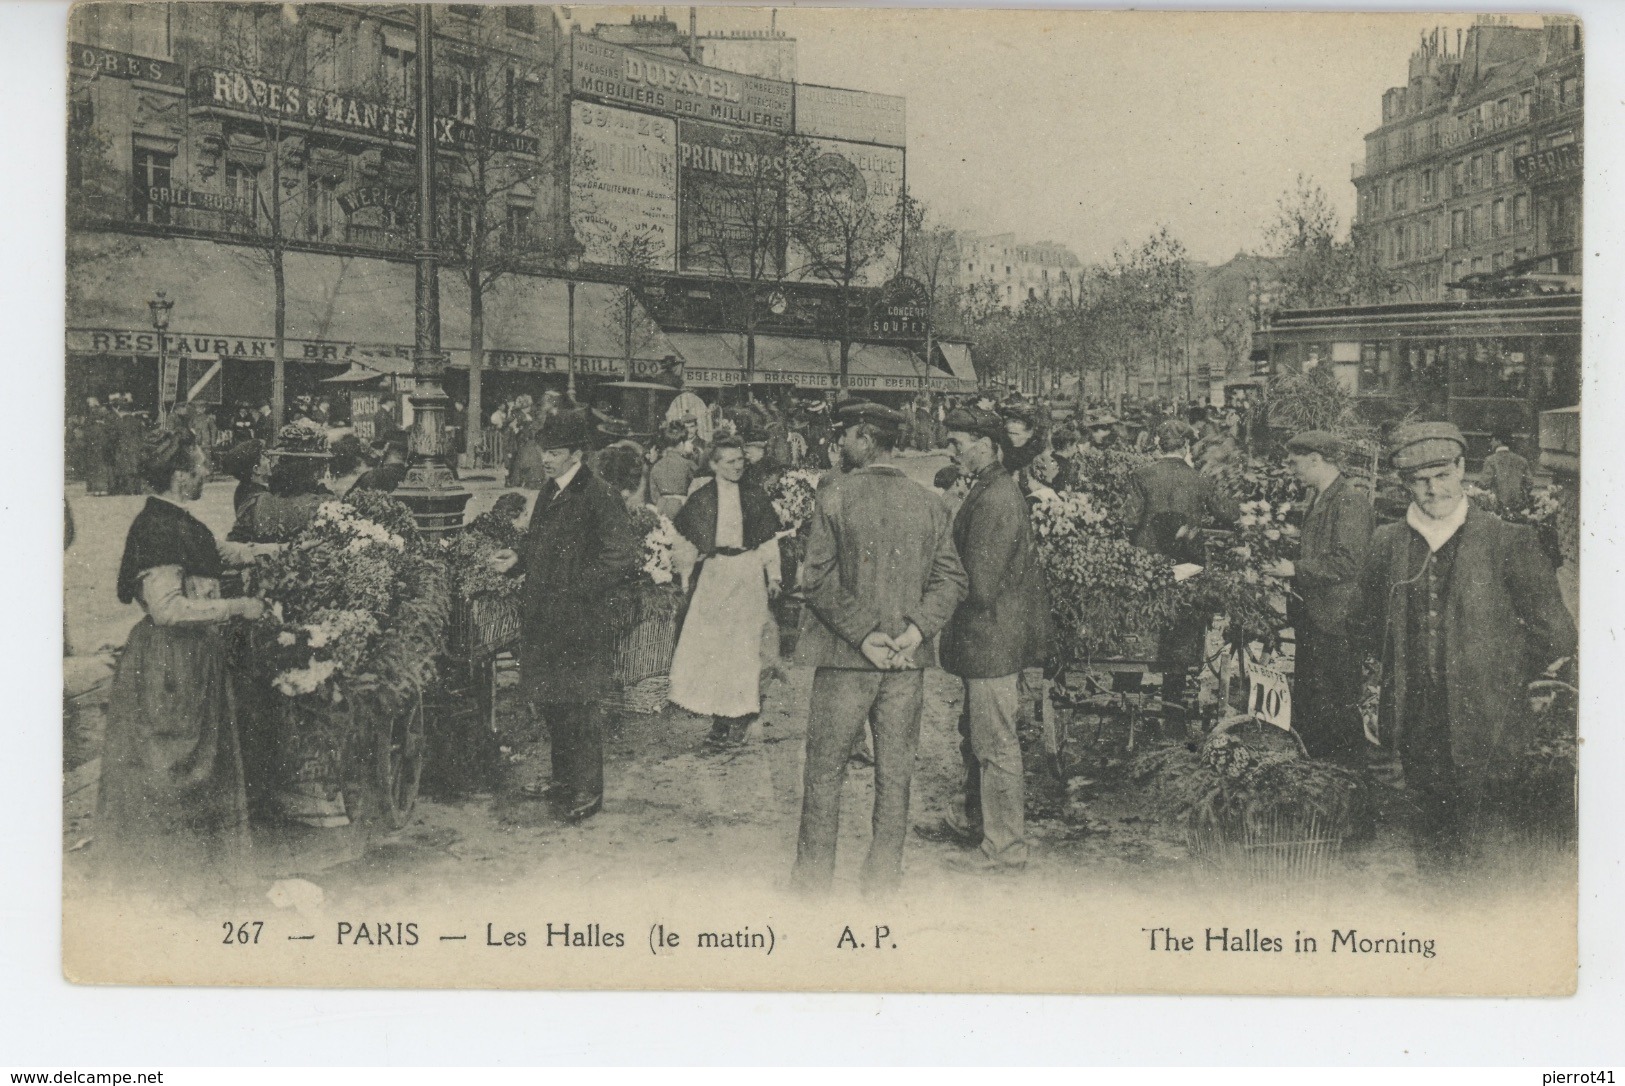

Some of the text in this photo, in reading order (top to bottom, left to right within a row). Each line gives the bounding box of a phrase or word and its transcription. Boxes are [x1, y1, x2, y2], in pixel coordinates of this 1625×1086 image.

[625, 56, 740, 104] DUFAYEL
[212, 71, 301, 113] ROBES
[325, 95, 455, 143] MANTEX
[581, 76, 665, 106] MOBILIERS
[674, 99, 702, 115] par
[710, 103, 784, 128] MILLIERS
[679, 142, 785, 180] PRINTEMPS
[149, 187, 197, 206] GRILL
[92, 333, 276, 357] RESTAURAN
[764, 373, 828, 387] BRASSERIE
